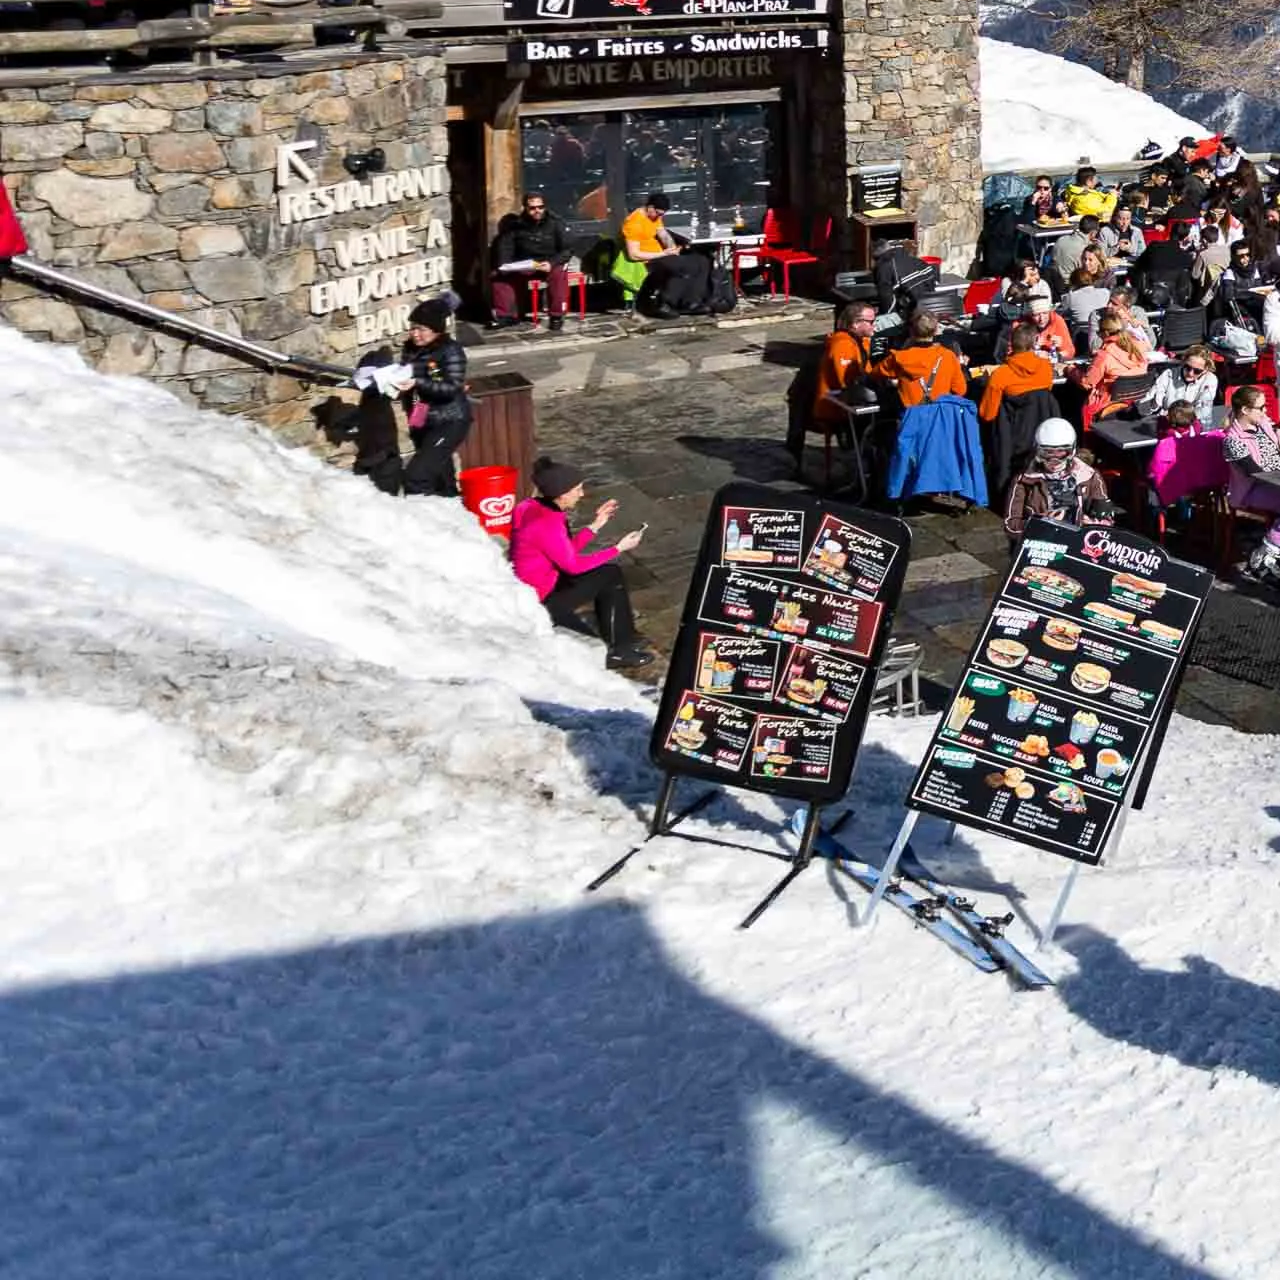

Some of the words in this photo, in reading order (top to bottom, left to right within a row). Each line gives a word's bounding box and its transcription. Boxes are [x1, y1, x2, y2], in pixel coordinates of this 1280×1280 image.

[335, 225, 417, 269] VENTE
[427, 219, 447, 249] A
[310, 256, 450, 316] EMPORTER
[747, 512, 796, 524] Formule
[836, 526, 883, 549] Formule
[847, 541, 885, 561] Source
[726, 571, 778, 593] Formule
[792, 589, 817, 603] des
[712, 635, 762, 648] Formule
[810, 655, 853, 673] Formule
[696, 699, 744, 717] Formule
[1038, 703, 1058, 715] PASTA
[759, 718, 806, 730] Formule
[968, 720, 988, 731] FRITES
[1100, 723, 1120, 734] PASTA
[802, 726, 837, 739] Berger
[1083, 775, 1104, 786] SOUPE
